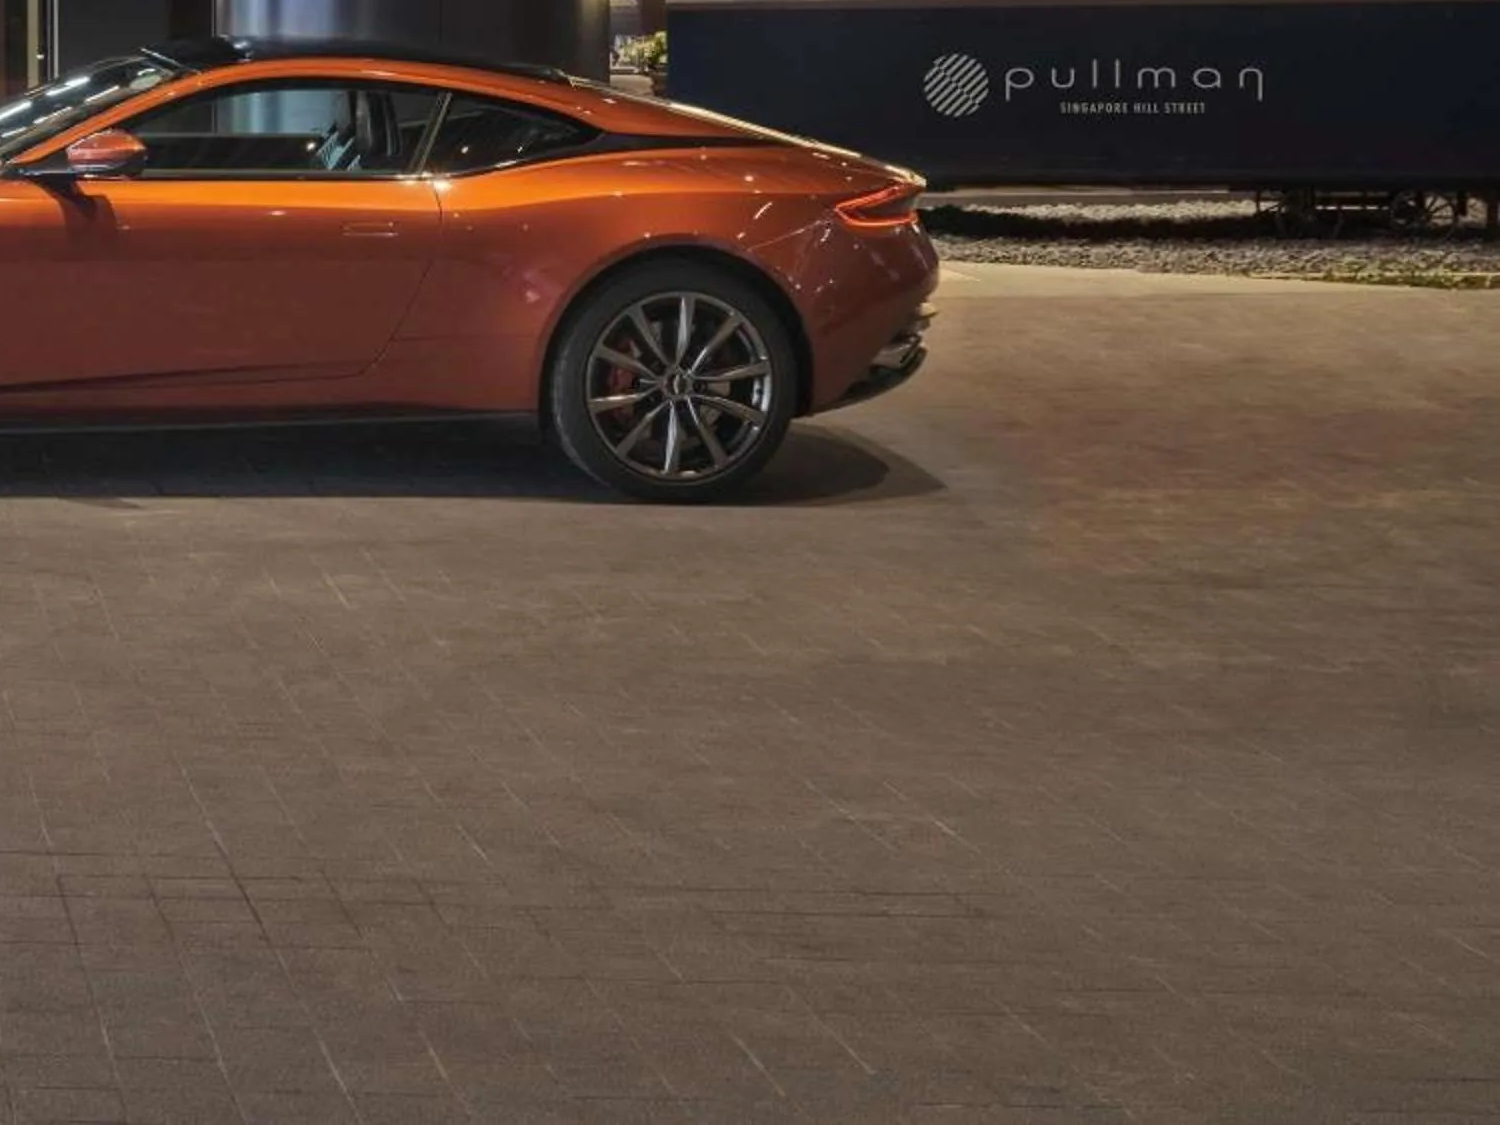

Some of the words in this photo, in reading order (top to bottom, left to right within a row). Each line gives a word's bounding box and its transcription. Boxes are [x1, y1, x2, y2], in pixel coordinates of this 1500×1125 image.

[1004, 58, 1263, 102] pullman
[1059, 101, 1128, 114] SINGAPORE
[1133, 101, 1159, 114] HILL
[1164, 101, 1206, 114] STREET
